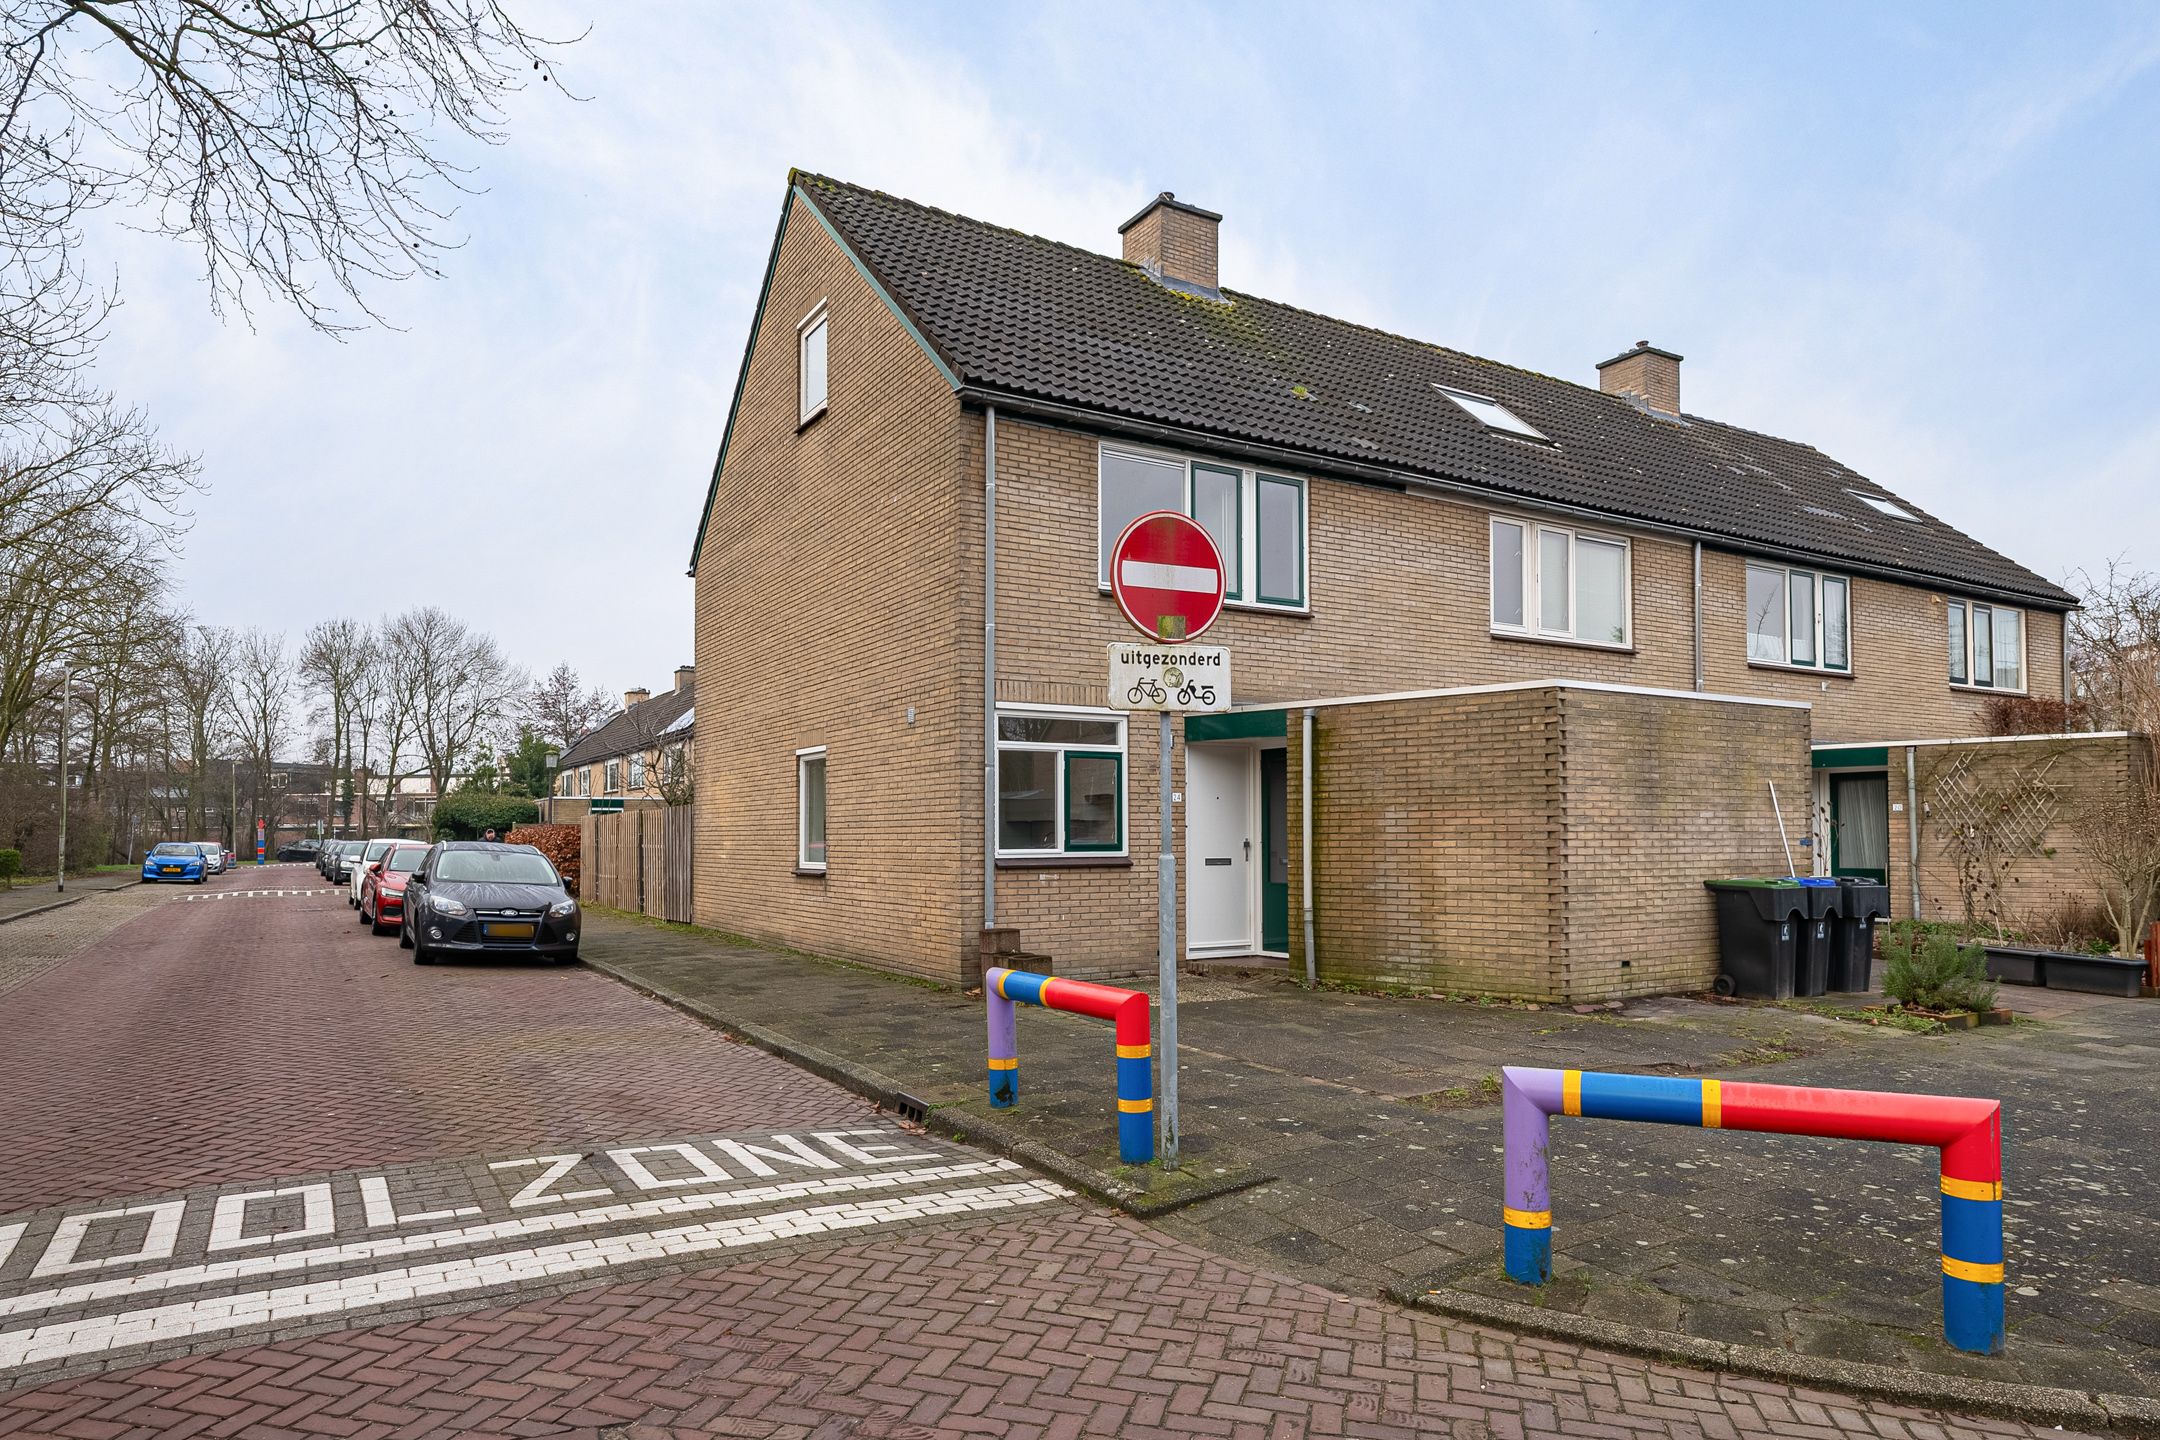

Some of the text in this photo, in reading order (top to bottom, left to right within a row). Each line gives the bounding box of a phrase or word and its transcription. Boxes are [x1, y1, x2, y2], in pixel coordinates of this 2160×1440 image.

[1120, 650, 1221, 669] uitgezonderd
[0, 1130, 943, 1279] OOL ZONE
